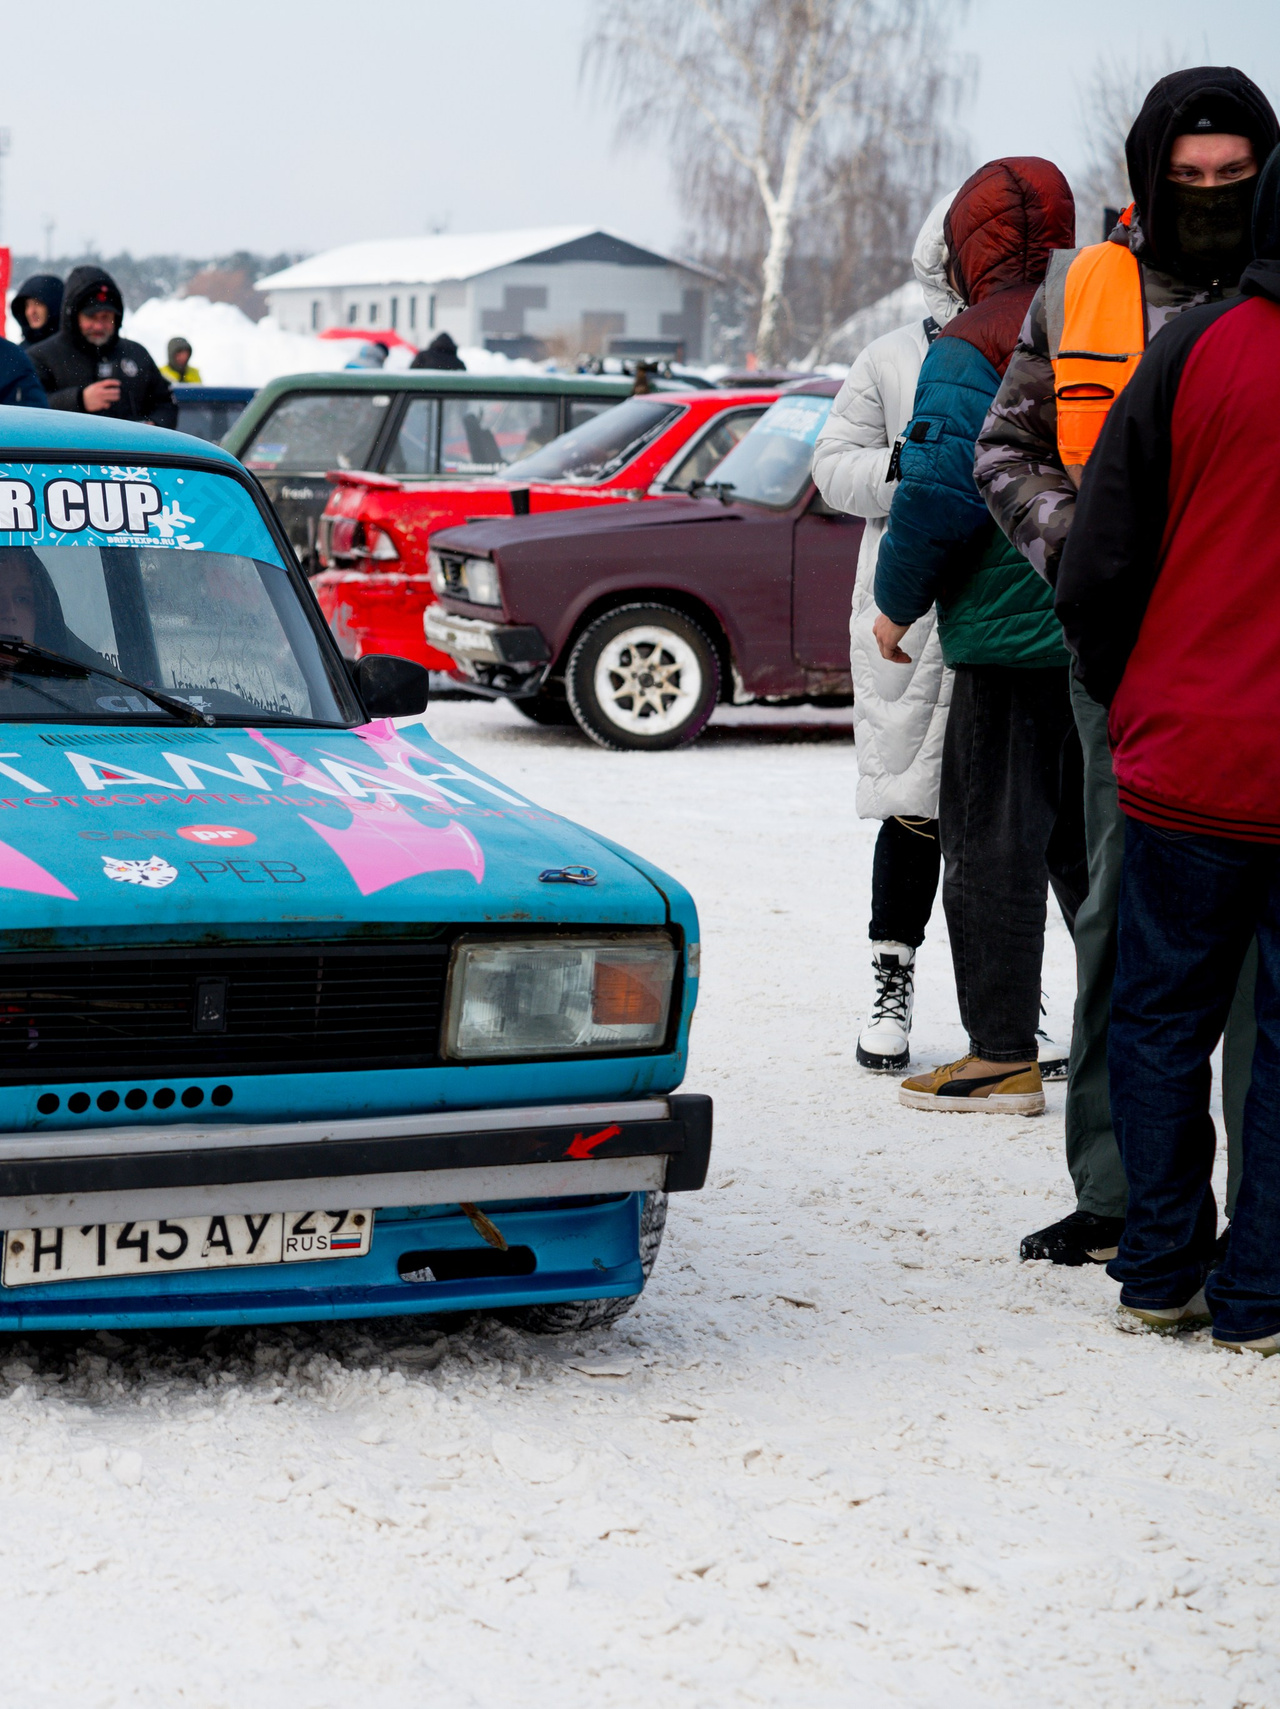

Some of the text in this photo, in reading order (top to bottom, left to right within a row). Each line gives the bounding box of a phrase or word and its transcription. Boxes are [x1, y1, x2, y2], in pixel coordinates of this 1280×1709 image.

[43, 478, 163, 534] CUP
[106, 535, 175, 546] DRIFTEXPO.RU
[421, 804, 561, 824] ФОНД
[77, 828, 239, 842] CAR pr
[184, 856, 307, 884] РЁВ
[286, 1235, 328, 1253] RUS
